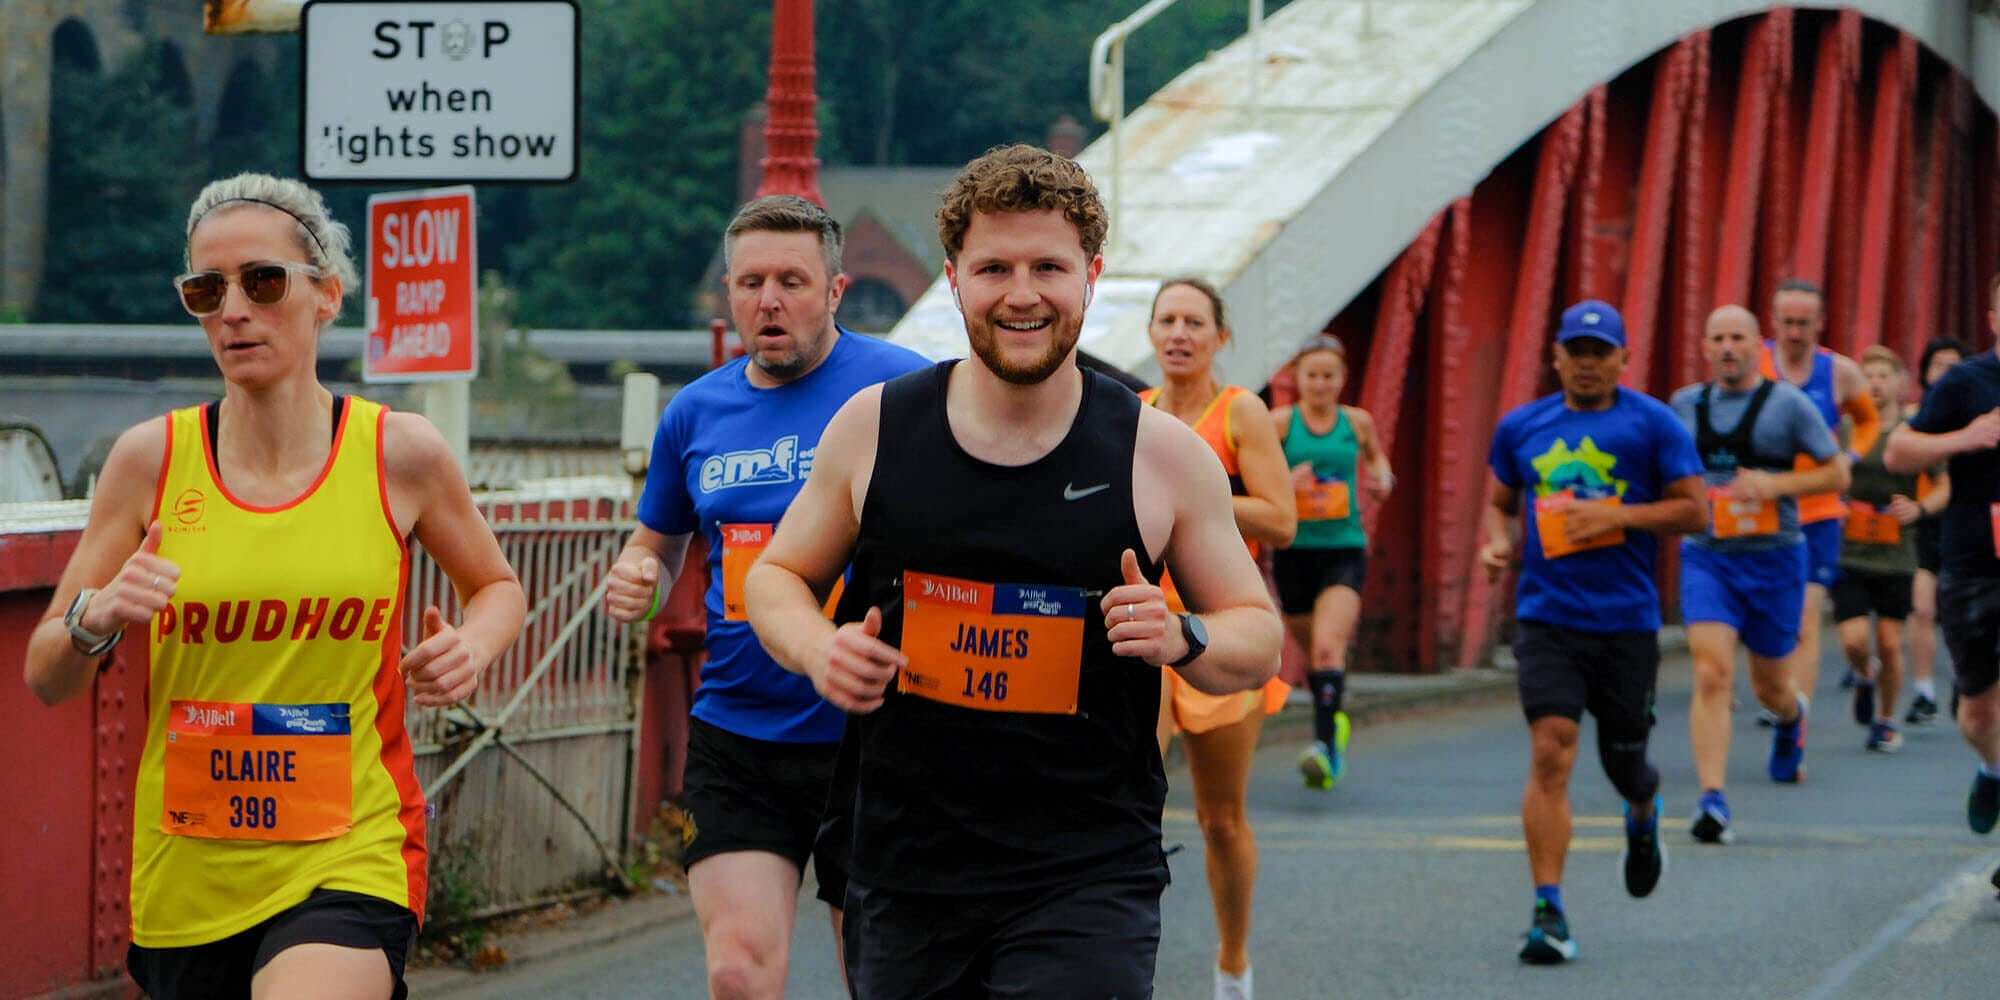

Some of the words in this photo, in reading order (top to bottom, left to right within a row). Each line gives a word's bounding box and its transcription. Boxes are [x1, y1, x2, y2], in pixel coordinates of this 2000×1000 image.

[372, 21, 510, 59] STP
[387, 81, 491, 112] when
[453, 126, 555, 157] show
[382, 208, 460, 269] SLOW
[395, 278, 446, 316] RAMP
[388, 321, 451, 359] AHEAD
[701, 435, 799, 494] emf
[934, 586, 978, 605] AJBell
[156, 597, 391, 644] PRUDHOE
[950, 623, 1029, 659] JAMES
[962, 667, 1008, 701] 146
[196, 709, 236, 728] AJBell
[210, 749, 296, 782] CLAIRE
[229, 795, 276, 829] 398
